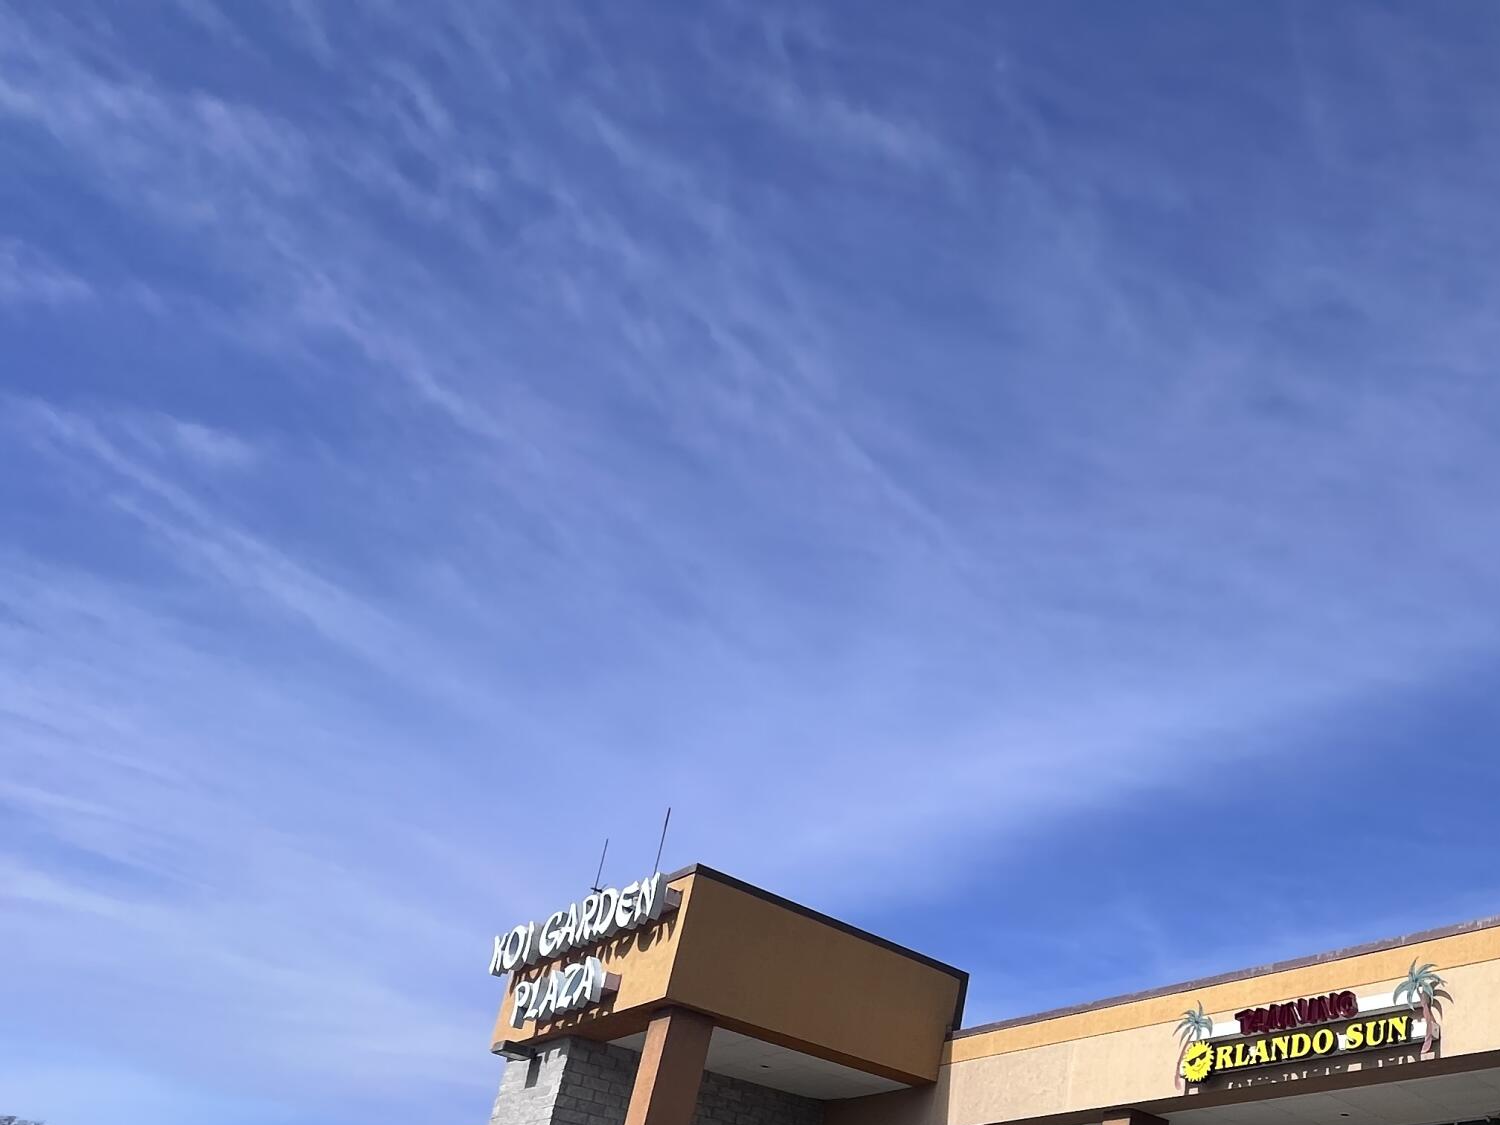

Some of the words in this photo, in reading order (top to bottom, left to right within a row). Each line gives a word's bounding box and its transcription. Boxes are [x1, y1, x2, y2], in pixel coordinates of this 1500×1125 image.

[489, 921, 537, 976] KOI
[539, 872, 663, 956] GARDEN
[509, 956, 594, 1028] PLAZA
[1346, 1016, 1410, 1049] SUN
